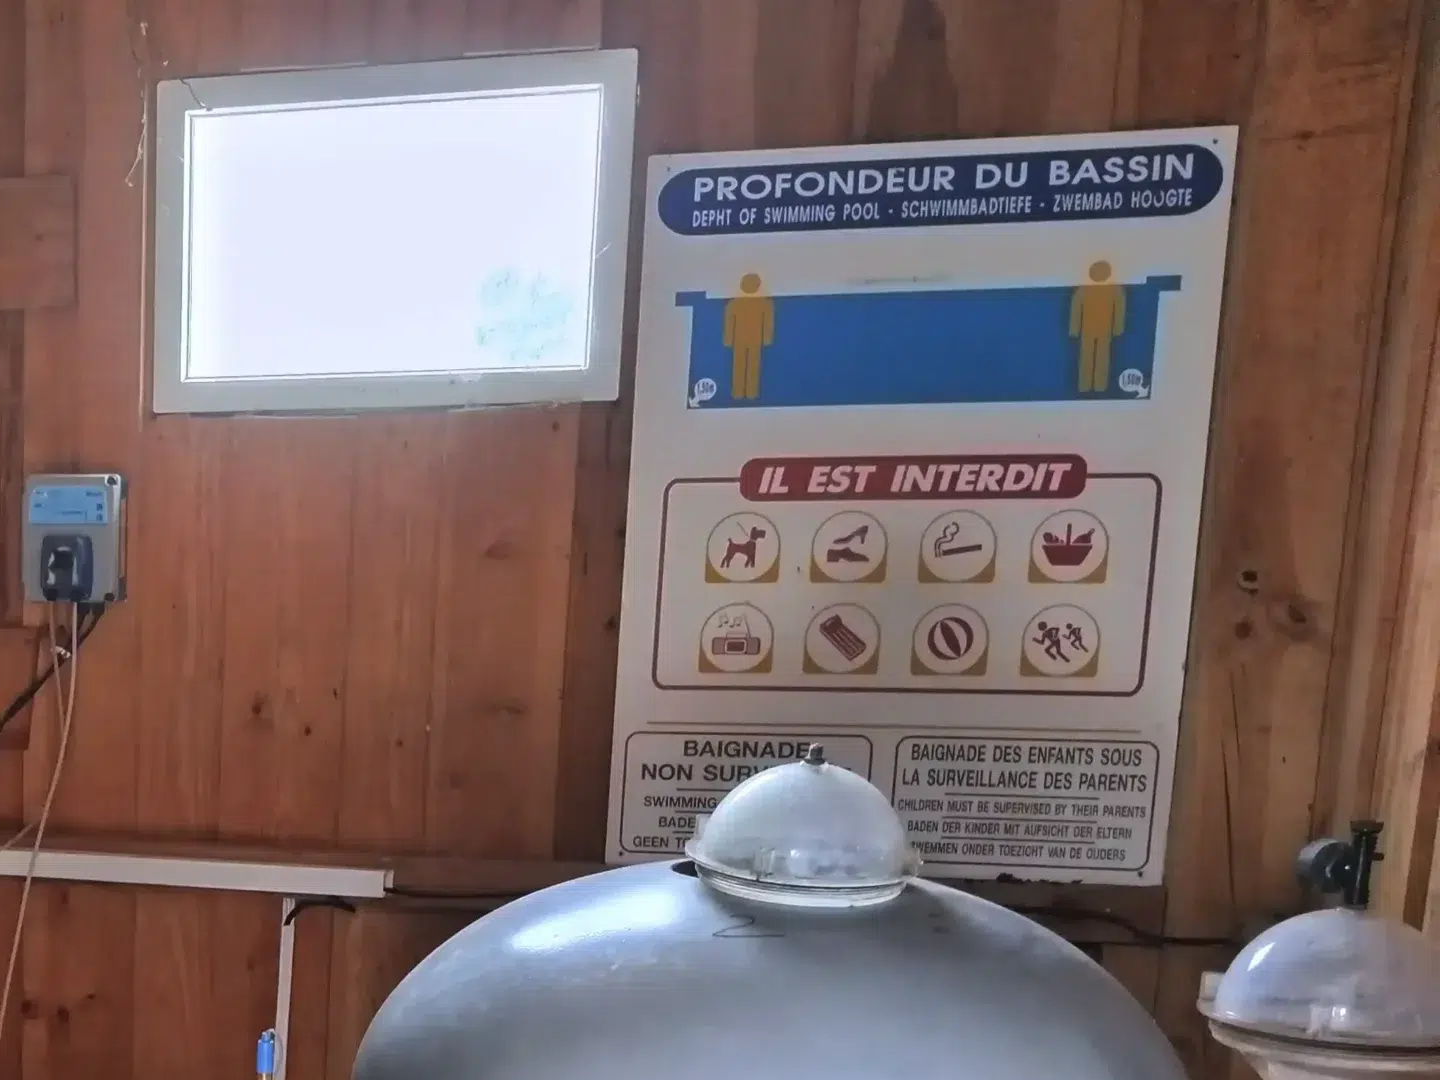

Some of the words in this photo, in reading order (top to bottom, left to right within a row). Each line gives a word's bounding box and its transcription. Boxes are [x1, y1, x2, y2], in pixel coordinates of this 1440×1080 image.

[693, 166, 955, 202] PROFONDEUR
[975, 161, 1028, 189] DU
[1049, 153, 1194, 186] BASSIN
[692, 209, 731, 228] DEPHT
[739, 207, 757, 225] OF
[764, 204, 835, 224] SWIMMING
[843, 202, 880, 221] POOL
[901, 196, 1032, 219] SCHWIMMBADTIEFE
[1053, 191, 1123, 212] ZWEMBAD
[759, 466, 789, 494] IL
[807, 465, 877, 493] EST
[890, 463, 1072, 492] INTERDIT
[683, 740, 810, 759] BAIGNADE
[911, 743, 986, 762] BAIGNADE
[993, 745, 1021, 763] DES
[1028, 746, 1094, 765] ENFANTS
[1101, 748, 1142, 766] SOUS
[641, 763, 693, 781] NON
[902, 768, 919, 785] LA
[927, 768, 1038, 789] SURVEILLANCE
[1044, 771, 1072, 790] DES
[1079, 773, 1147, 792] PARENTS
[644, 795, 717, 809] SWIMMING
[898, 799, 943, 811] CHILDREN
[947, 800, 973, 812] MUST
[977, 801, 992, 813] BE
[994, 801, 1051, 815] SUPERVISED
[1055, 803, 1067, 815] BY
[1071, 804, 1098, 816] THEIR
[1103, 805, 1146, 818] PARENTS
[658, 816, 696, 828] BADE
[908, 820, 938, 832] BADEN
[942, 821, 960, 833] DER
[965, 822, 999, 834] KINDER
[1004, 823, 1020, 835] MIT
[1024, 824, 1069, 837] AUFSICHT
[1073, 826, 1092, 838] DER
[1097, 827, 1132, 839] ELTERN
[633, 835, 669, 848] GEEN
[962, 843, 995, 856] ONDER
[1000, 844, 1044, 857] TOEZICHT
[1048, 847, 1066, 858] VAN
[1070, 847, 1082, 859] DE
[1086, 848, 1126, 861] OUDERS
